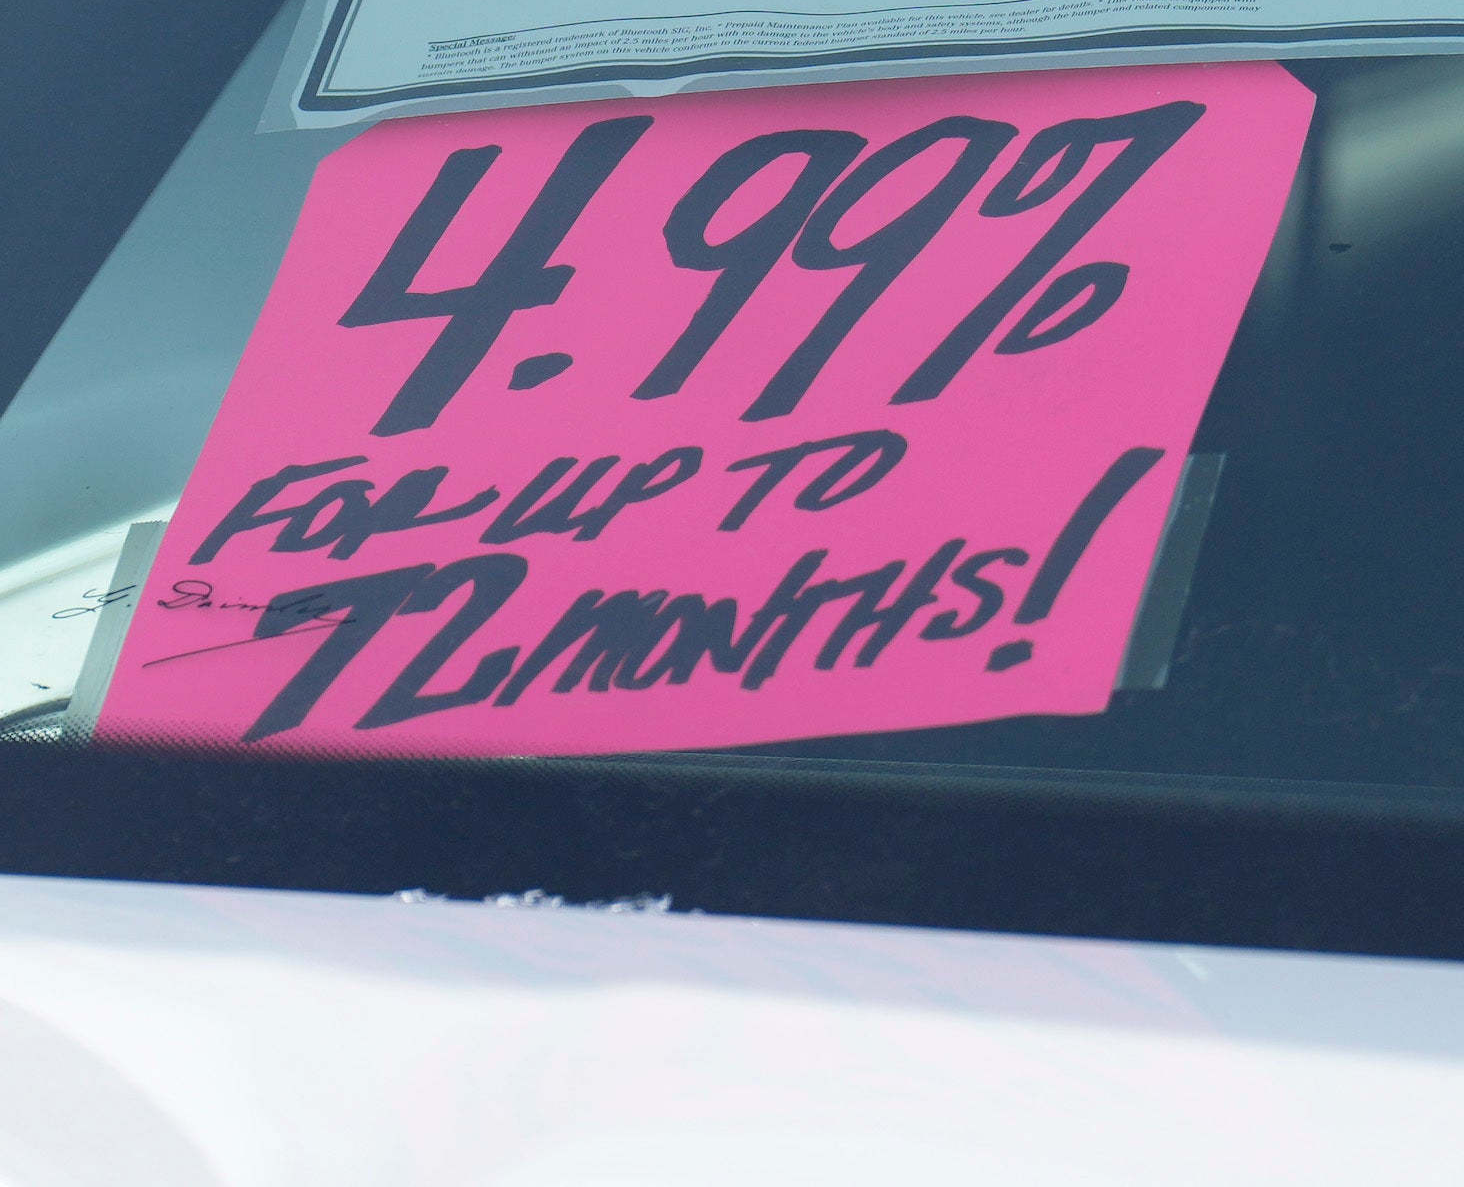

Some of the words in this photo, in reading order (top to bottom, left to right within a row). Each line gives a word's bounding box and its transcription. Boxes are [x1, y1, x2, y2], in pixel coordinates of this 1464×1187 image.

[429, 40, 470, 52] Special
[469, 33, 517, 48] Message:
[338, 101, 1206, 435] 4.99%
[188, 456, 498, 565] FOR
[493, 446, 704, 544] UP
[718, 429, 908, 532] TO
[242, 553, 529, 742] 72
